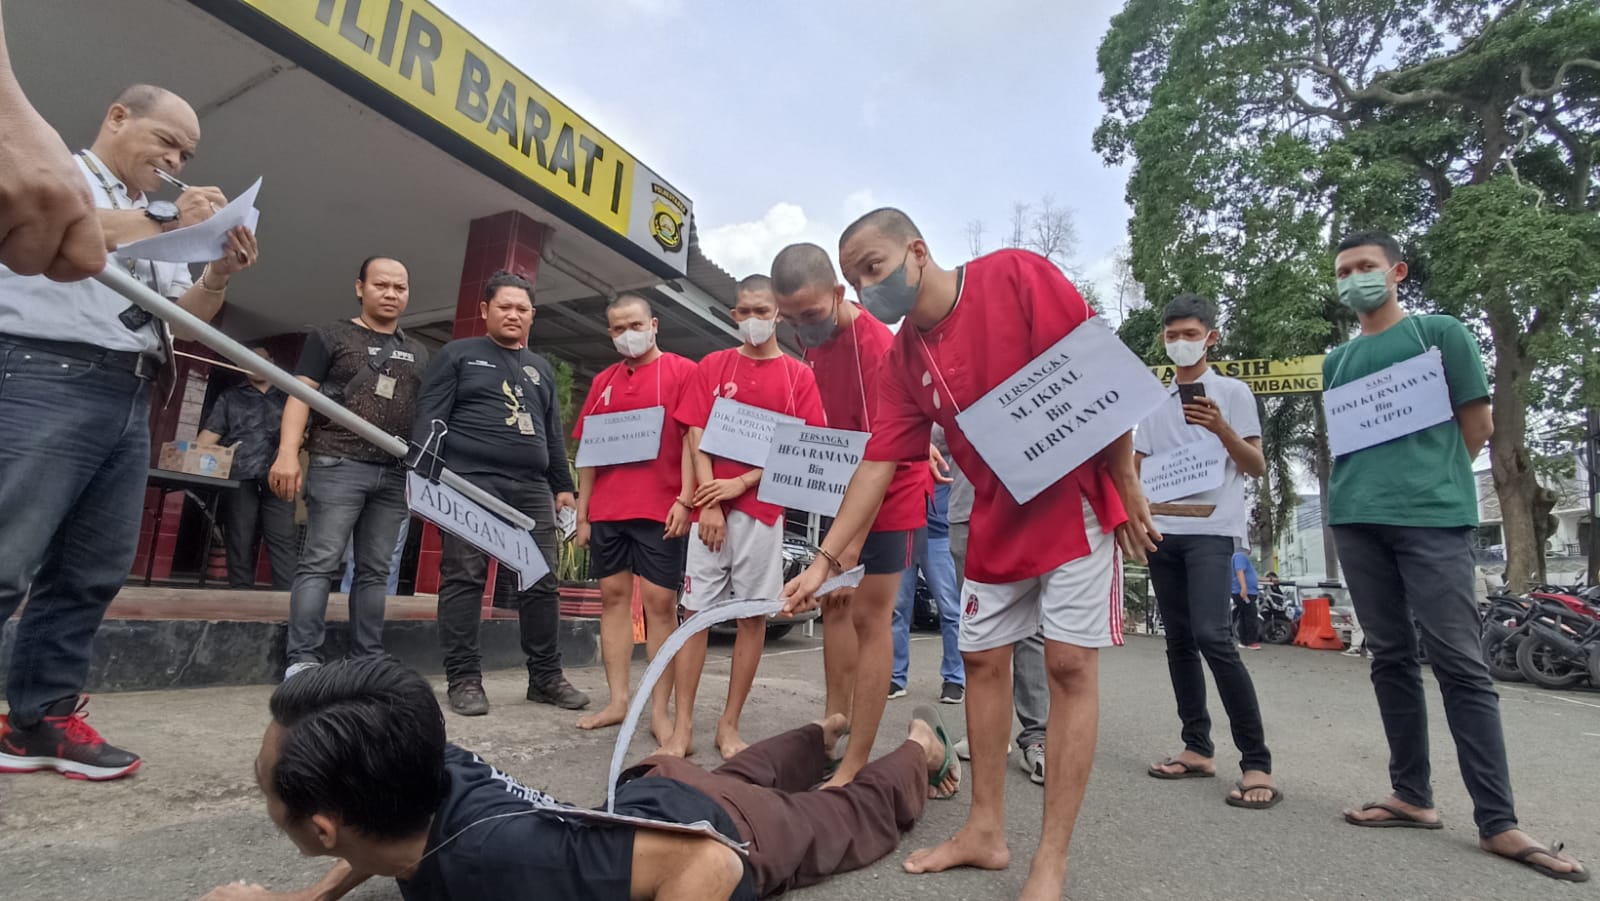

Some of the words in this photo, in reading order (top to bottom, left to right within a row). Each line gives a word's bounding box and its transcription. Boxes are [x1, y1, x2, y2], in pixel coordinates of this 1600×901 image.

[455, 49, 604, 196] BARAT
[999, 353, 1070, 406] TERSANGKA
[1010, 406, 1033, 423] M.
[1031, 370, 1083, 408] IKBAL
[1330, 399, 1358, 416] TONI
[1360, 370, 1438, 406] KURNIAWAN
[1045, 402, 1072, 422] Bin
[1360, 406, 1413, 429] SUCIPTO
[1375, 401, 1392, 413] Bin
[1023, 390, 1119, 461] HERIYANTO
[800, 432, 849, 446] TERSANGKA
[778, 444, 807, 458] HEGA
[772, 472, 803, 488] HOLIL
[808, 463, 824, 476] Bin
[420, 484, 506, 549] ADEGAN
